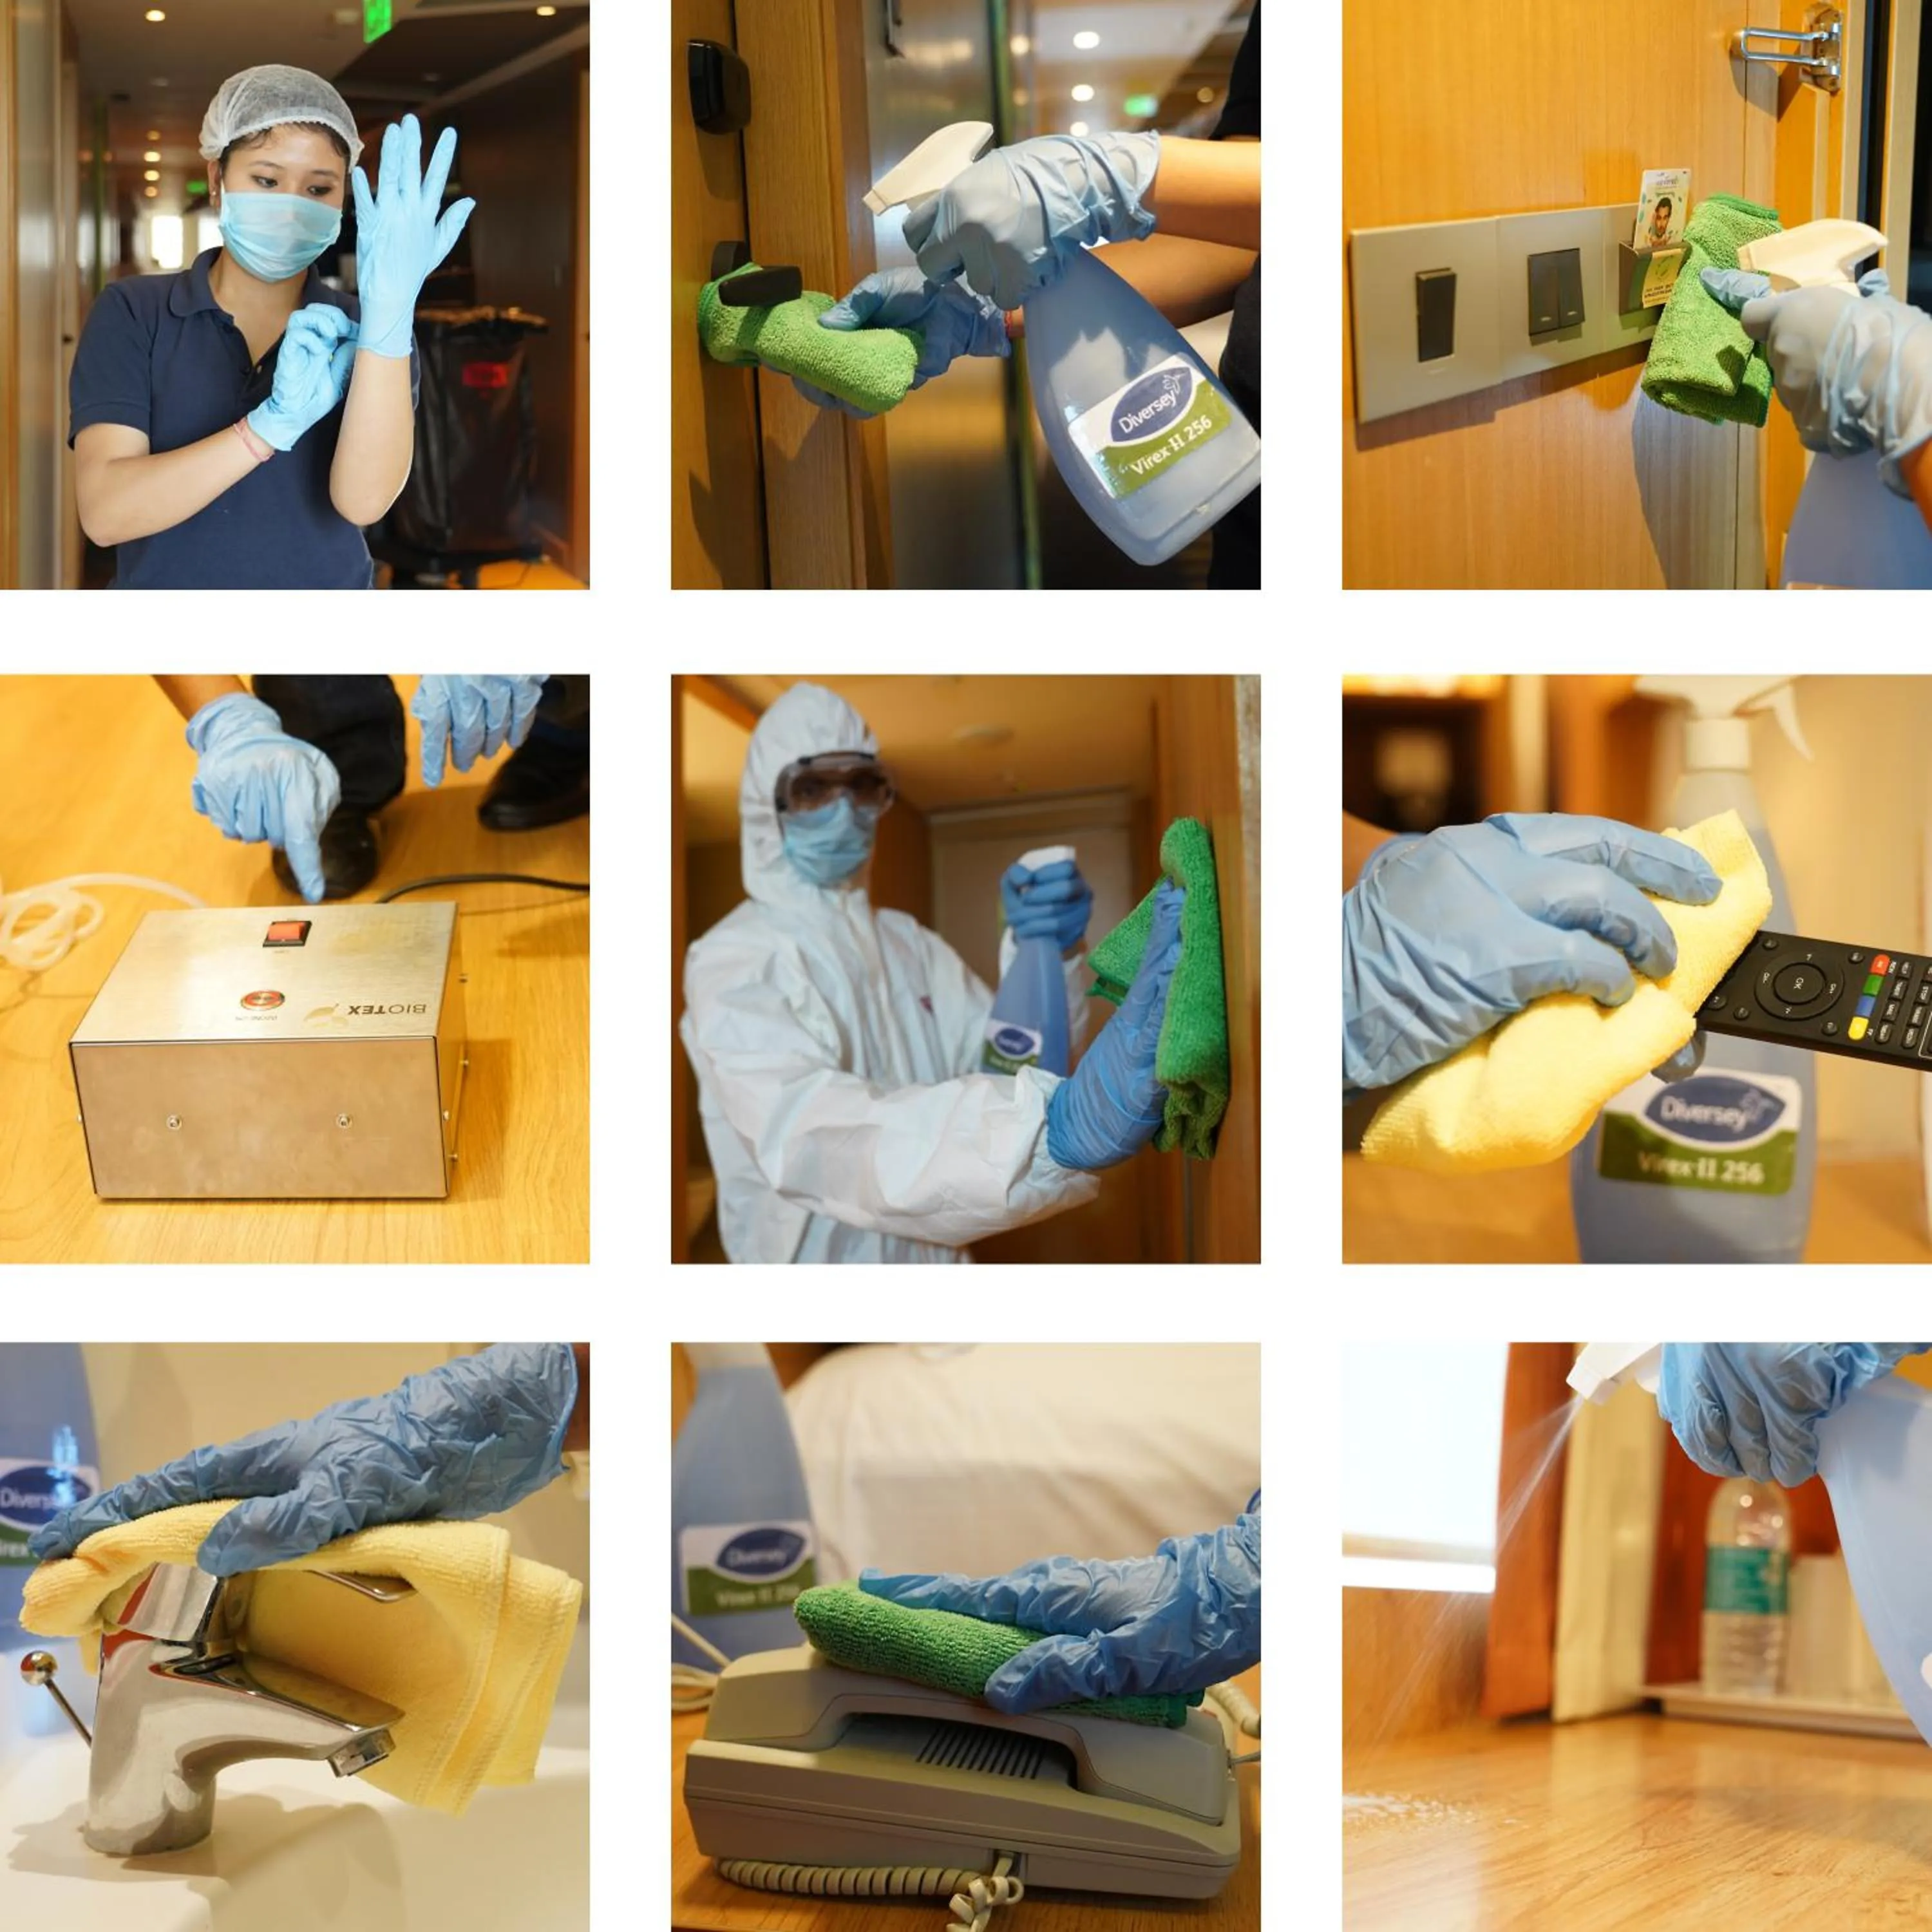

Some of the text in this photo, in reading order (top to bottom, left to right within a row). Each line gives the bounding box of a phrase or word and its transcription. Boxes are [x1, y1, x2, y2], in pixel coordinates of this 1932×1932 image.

[1118, 390, 1177, 434] Diversey
[1129, 446, 1171, 475] Virex
[1183, 415, 1213, 442] 256
[1793, 977, 1804, 990] OK
[1920, 985, 1929, 1000] STOP
[347, 1003, 426, 1016] BIOTEX
[1660, 1095, 1747, 1132] Diversey
[1638, 1151, 1693, 1178] Virex
[1721, 1160, 1765, 1185] 256
